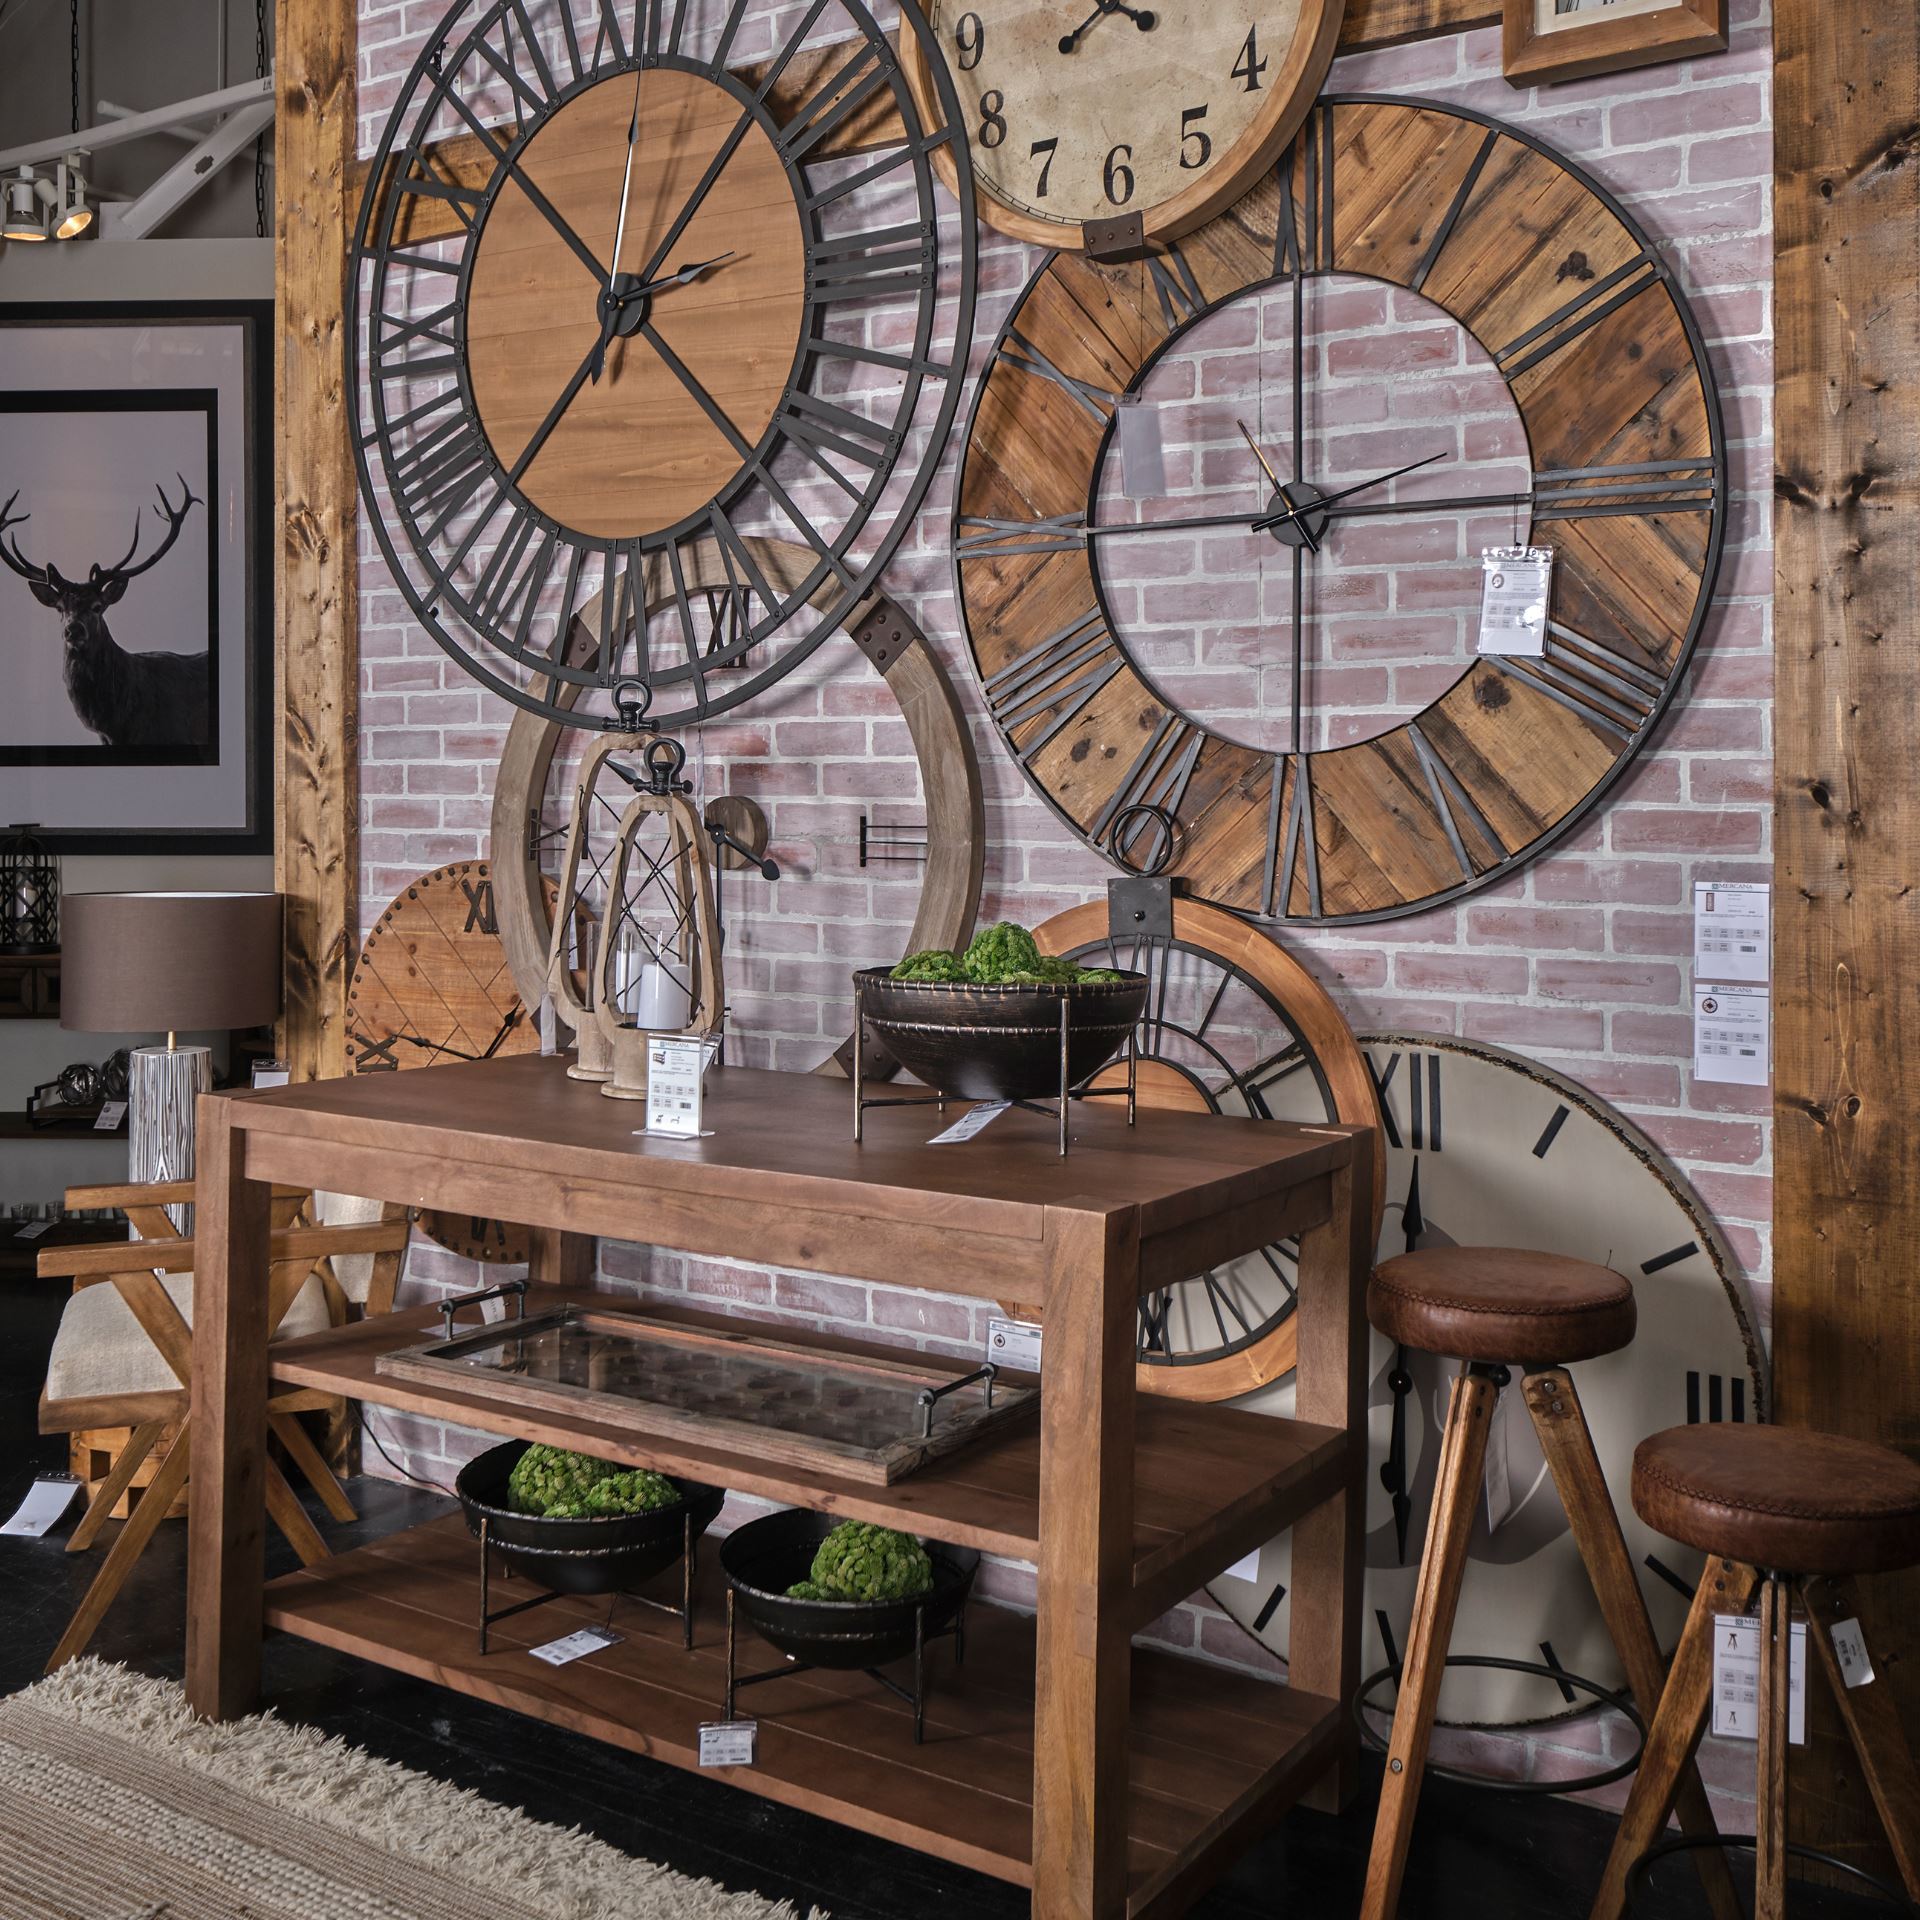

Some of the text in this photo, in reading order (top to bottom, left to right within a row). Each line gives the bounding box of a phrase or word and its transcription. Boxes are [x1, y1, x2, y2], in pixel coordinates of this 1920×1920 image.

[955, 12, 984, 71] 9
[1230, 22, 1268, 93] 4
[978, 89, 1007, 148] 8
[1179, 103, 1212, 169] 5
[1029, 137, 1059, 198] 7
[1103, 144, 1134, 206] 6
